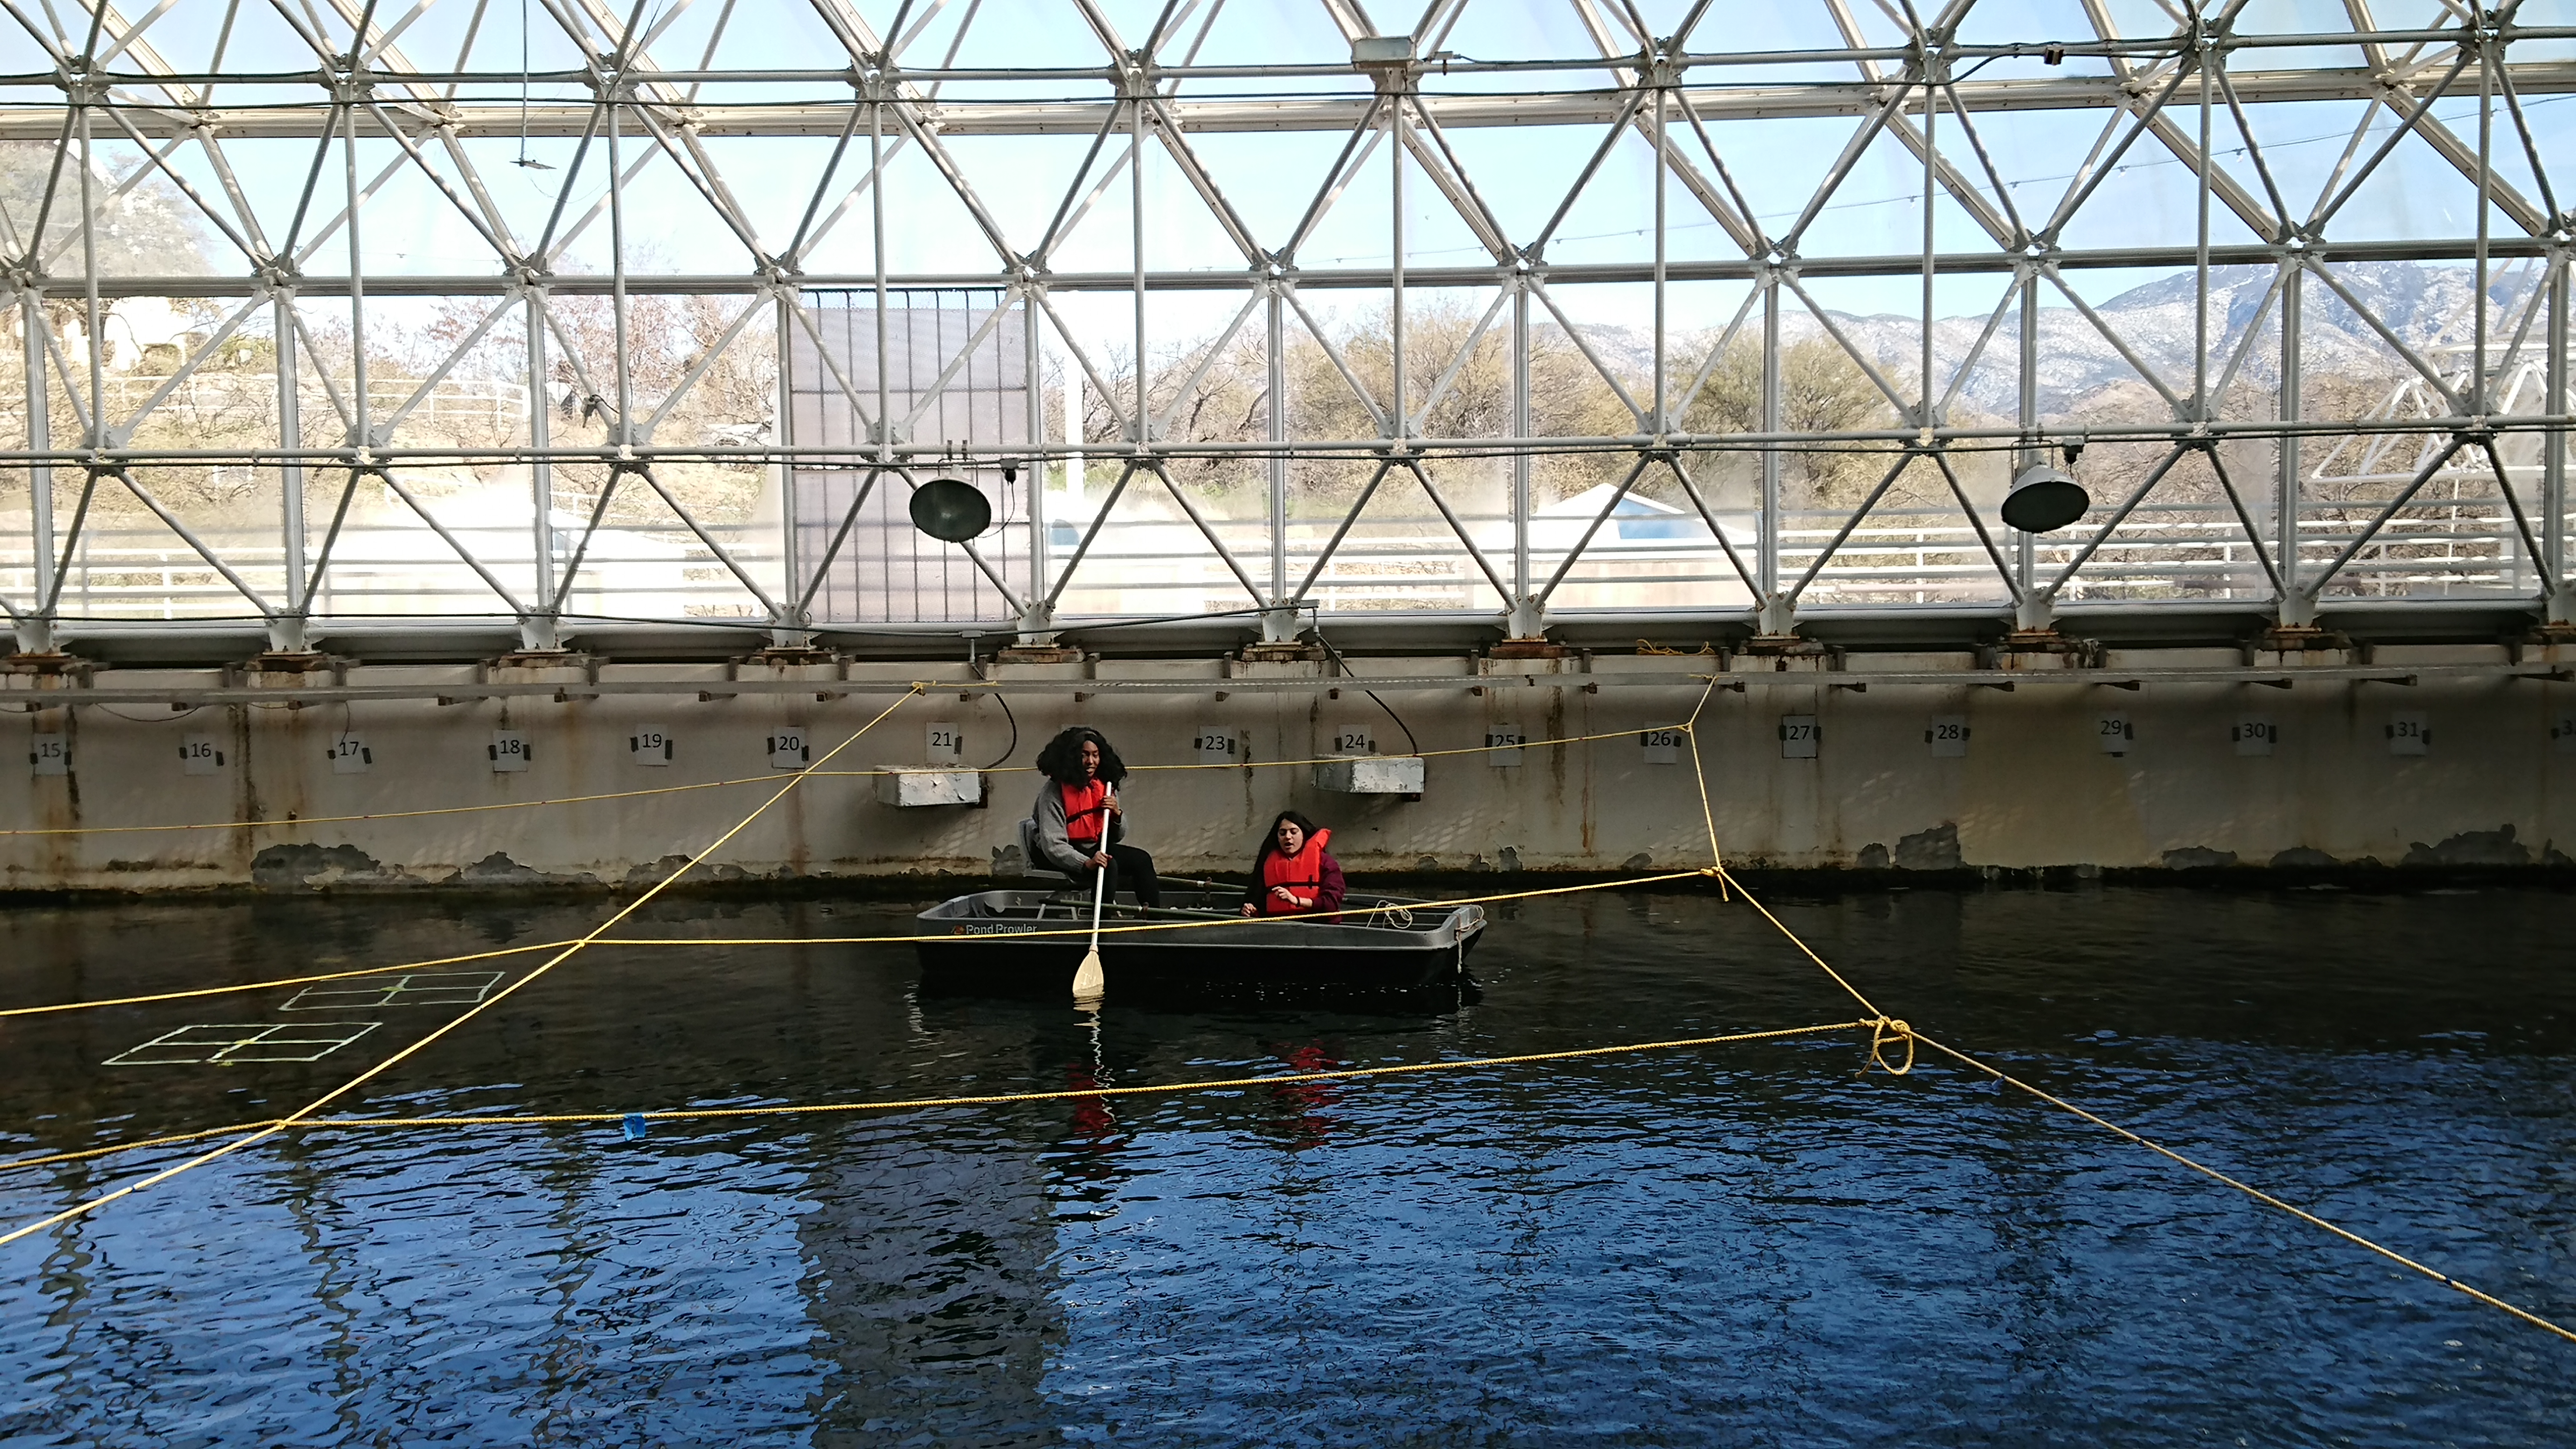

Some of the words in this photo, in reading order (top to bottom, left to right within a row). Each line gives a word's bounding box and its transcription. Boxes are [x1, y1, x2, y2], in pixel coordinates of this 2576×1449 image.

[1789, 725, 1810, 740] 27
[1938, 724, 1959, 739] 28
[2100, 720, 2121, 735] 29
[2244, 723, 2265, 738] 30
[2397, 722, 2419, 737] 31
[2562, 720, 2576, 735] 3
[642, 733, 662, 747] 19
[779, 736, 799, 750] 20
[932, 732, 952, 746] 21
[1206, 736, 1225, 750] 23
[1346, 734, 1365, 749] 24
[1495, 734, 1515, 748] 25
[1650, 732, 1671, 746] 26
[41, 743, 61, 757] 15
[191, 743, 211, 757] 16
[339, 741, 359, 755] 17
[500, 740, 520, 754] 18
[966, 924, 993, 935] Pond
[996, 923, 1037, 934] Prowler
